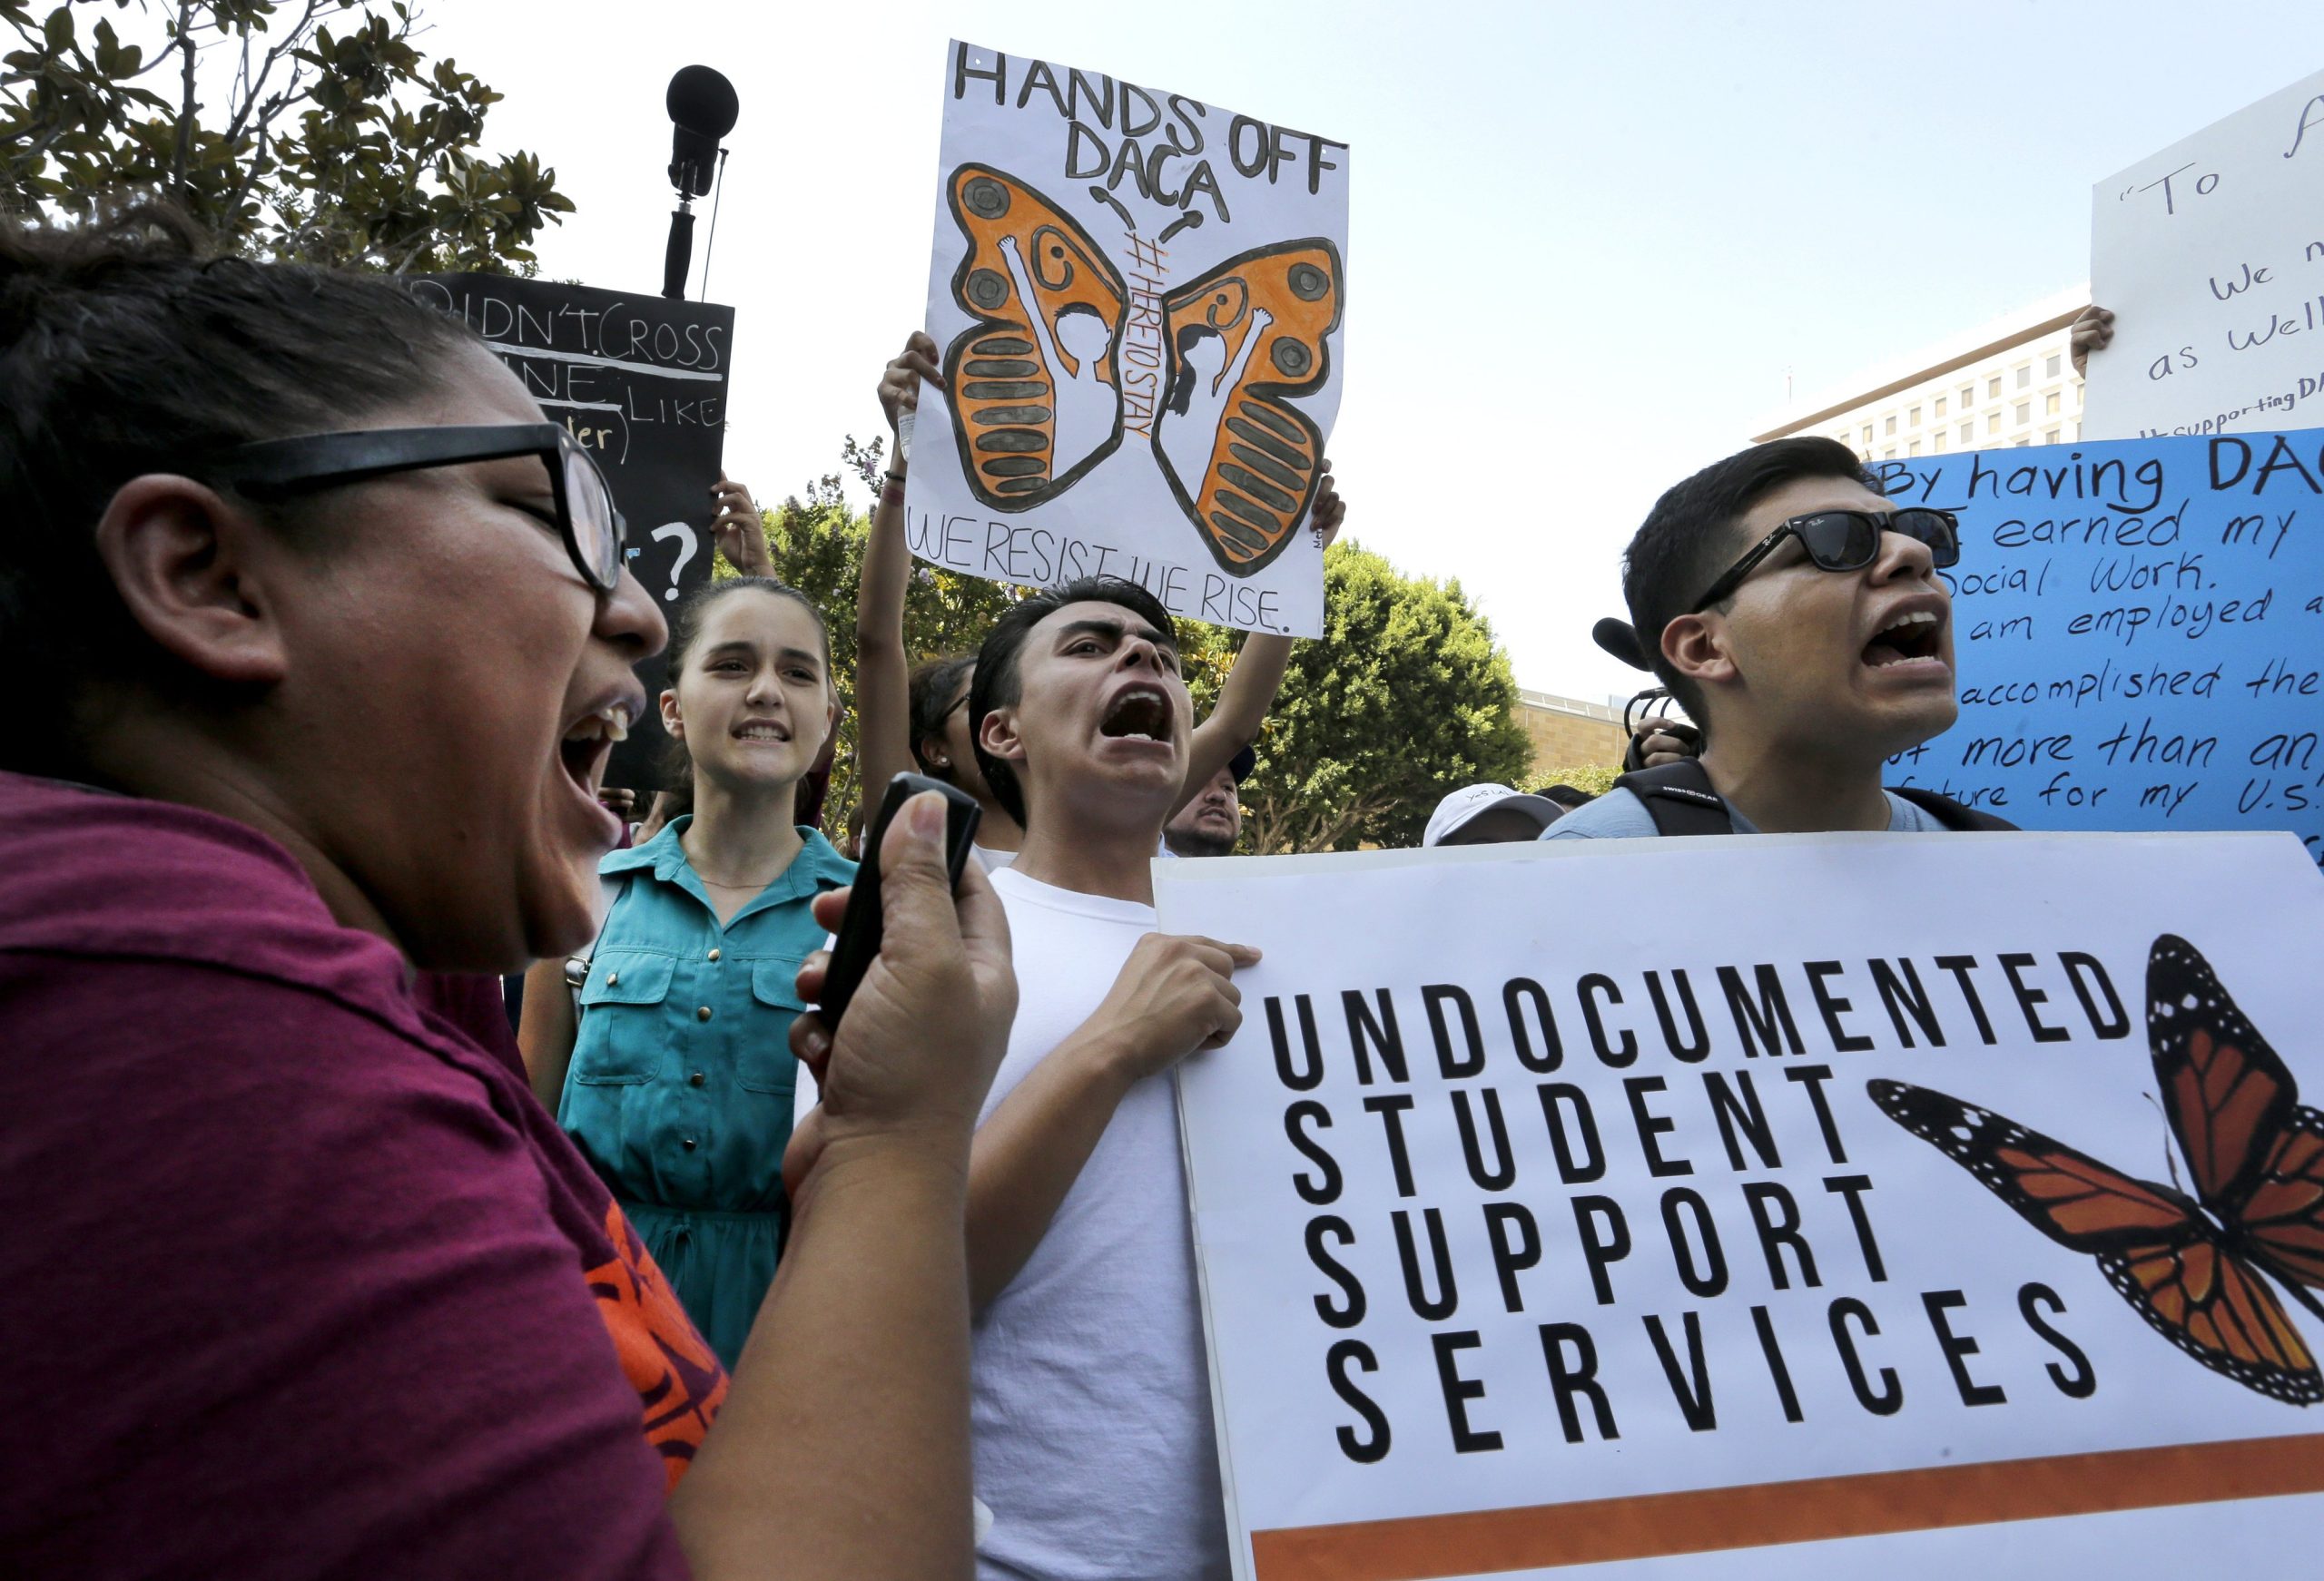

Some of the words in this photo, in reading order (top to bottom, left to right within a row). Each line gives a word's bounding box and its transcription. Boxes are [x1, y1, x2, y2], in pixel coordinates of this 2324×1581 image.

[954, 42, 1206, 155] HANDS
[1228, 114, 1349, 195] OFF
[1066, 121, 1230, 222] DACA
[2210, 263, 2273, 300] We
[2148, 347, 2198, 381] as
[628, 386, 724, 427] LIKE
[1878, 462, 1943, 503] By
[1968, 453, 2163, 514] having
[2209, 435, 2324, 495] DA
[1994, 498, 2191, 547] earned
[2221, 510, 2297, 560] my
[908, 506, 977, 567] WE
[984, 522, 1118, 585] RESIST
[1201, 574, 1291, 633] RISE.
[1969, 615, 2033, 641] am
[2067, 589, 2272, 646] employed
[1961, 658, 2222, 709] accomplished
[2247, 658, 2319, 697] the
[1962, 735, 2075, 766] more
[2097, 718, 2217, 768] than
[2039, 772, 2107, 808] for
[2140, 781, 2200, 817] my
[1265, 950, 2131, 1091] UNDOCUMENTED
[1284, 1064, 1847, 1205] STUDENT
[1305, 1174, 1887, 1330] SUPPORT
[1325, 1281, 2097, 1464] SERVICES
